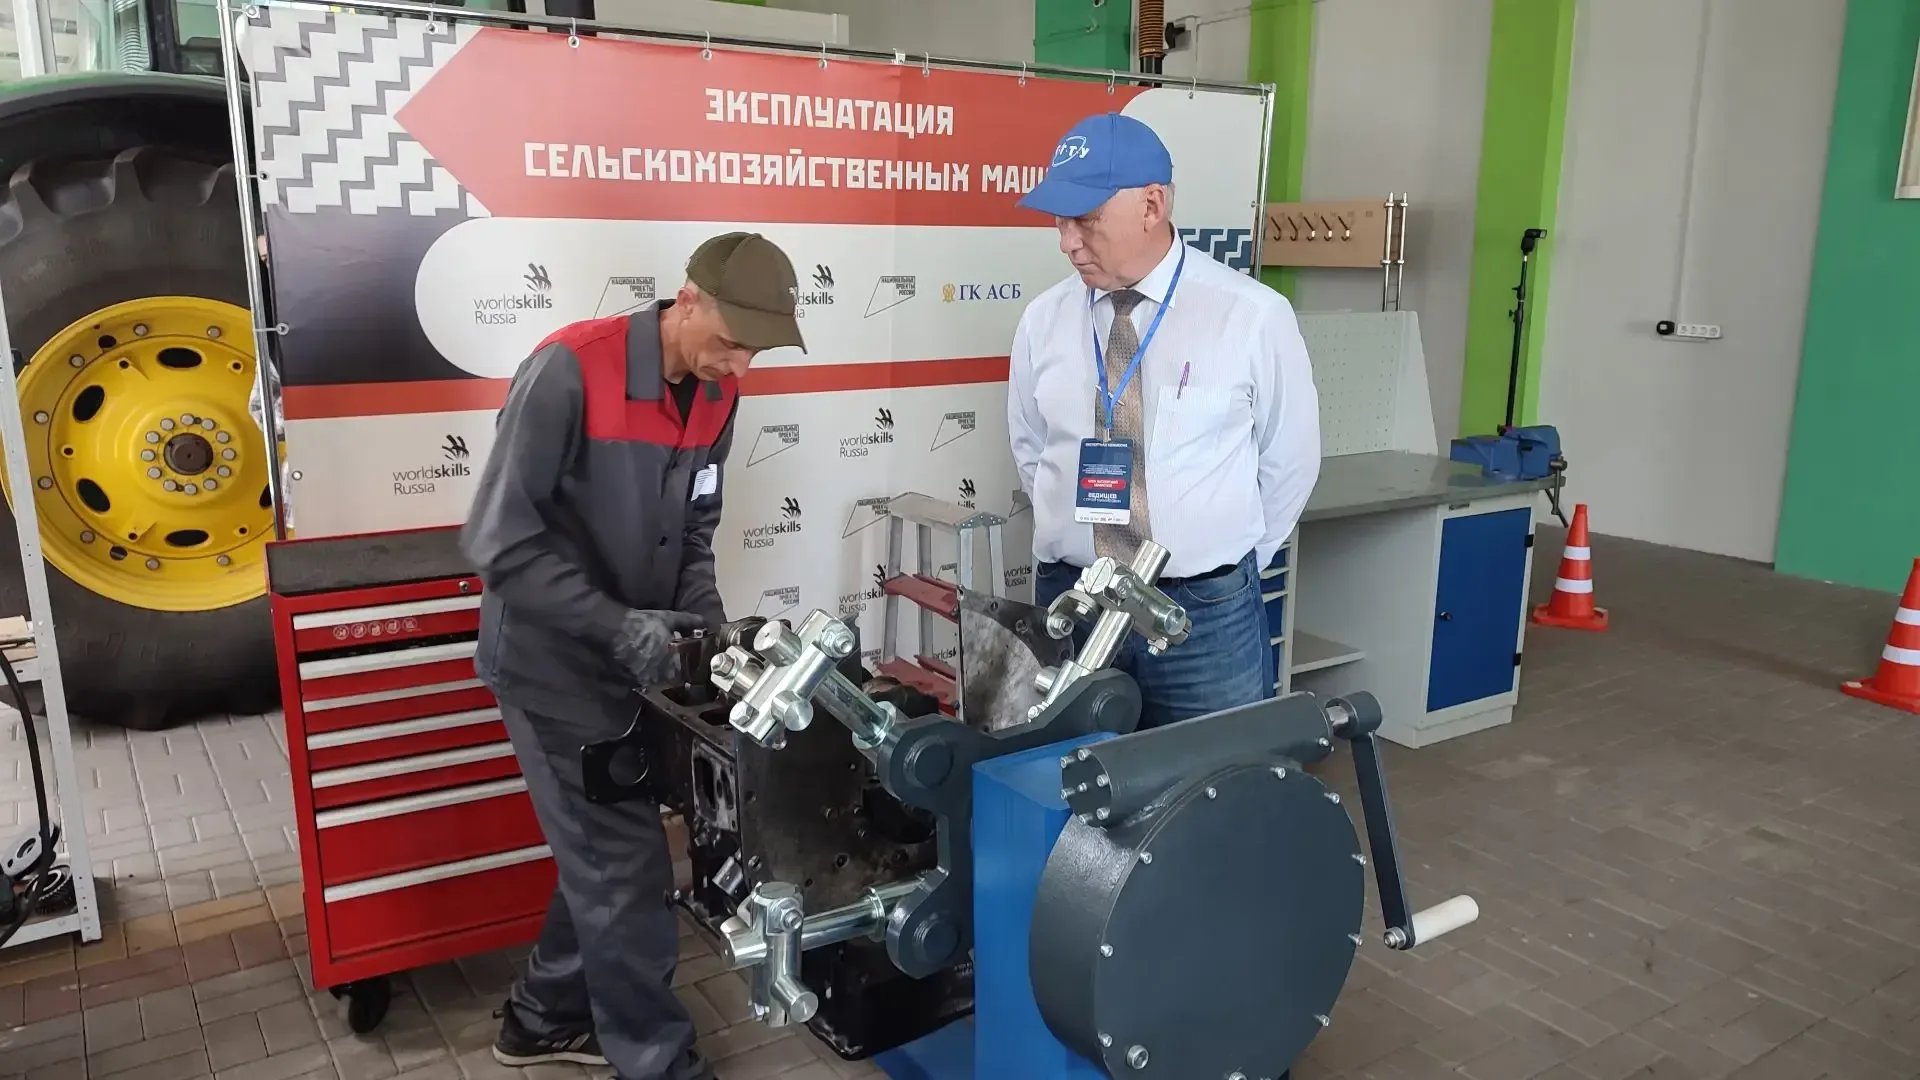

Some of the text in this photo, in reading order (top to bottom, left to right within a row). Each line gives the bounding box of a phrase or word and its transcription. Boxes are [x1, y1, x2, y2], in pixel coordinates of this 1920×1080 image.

[705, 87, 955, 138] ЭКСПЛУАТАЦИЯ
[524, 141, 1048, 194] СЕЛЬСКОХОЗЯЙСТВЕННЫХ МАШ
[797, 291, 834, 305] dskills
[959, 283, 1021, 301] ГК АСБ
[473, 294, 553, 311] worldskills
[475, 310, 517, 325] Russia
[839, 431, 894, 447] worldskills
[839, 446, 869, 459] Russia
[392, 463, 471, 482] worldskills
[393, 480, 436, 496] Russia
[743, 521, 802, 538] worldskills
[743, 537, 775, 549] Russia
[1004, 564, 1032, 577] worlds
[838, 587, 885, 604] worldskil
[838, 602, 867, 615] Russia
